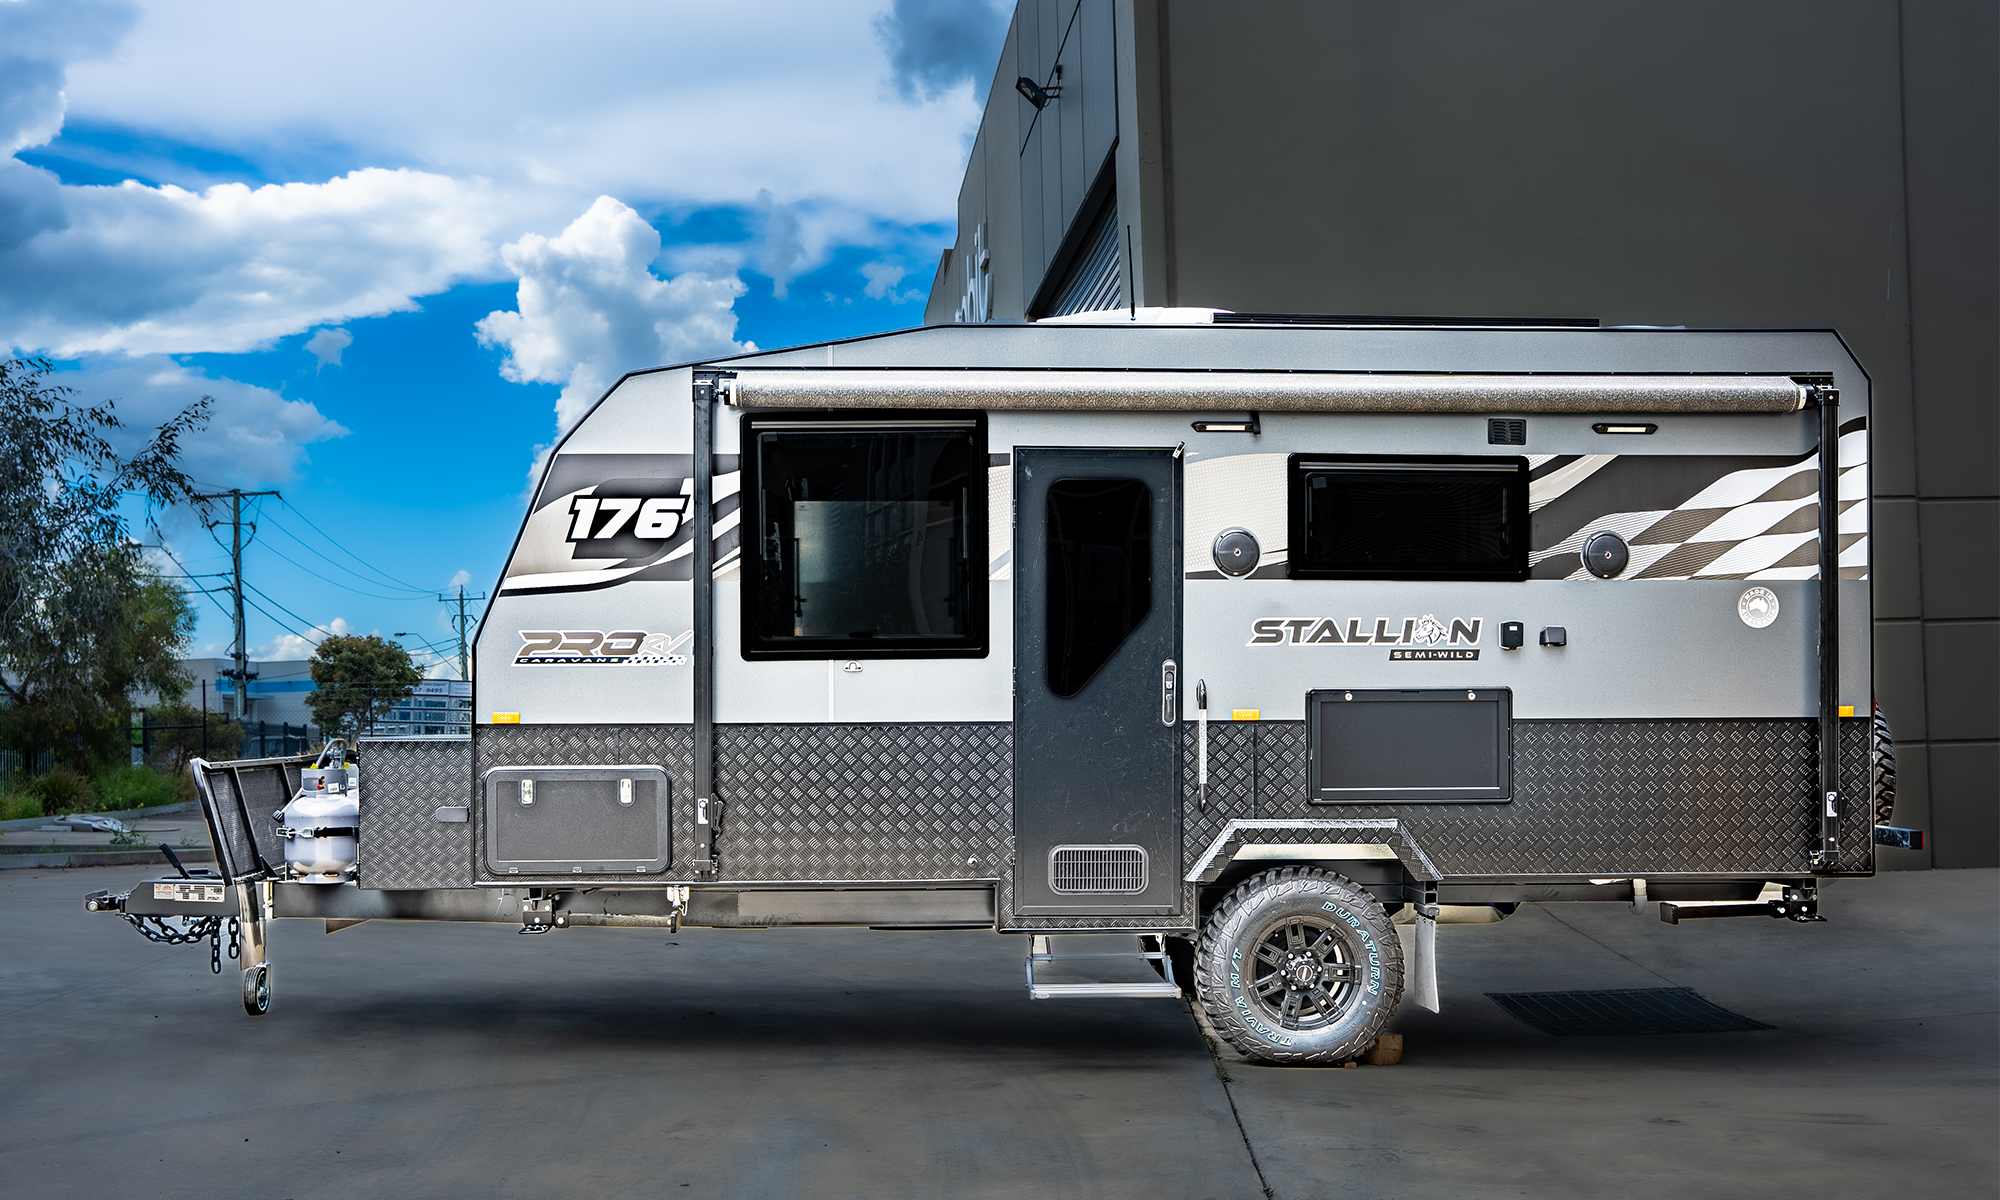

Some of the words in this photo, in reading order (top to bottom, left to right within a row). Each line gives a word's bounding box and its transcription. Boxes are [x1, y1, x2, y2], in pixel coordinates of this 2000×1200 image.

[570, 498, 686, 539] 176
[1744, 589, 1765, 600] MADE
[1765, 592, 1774, 601] IN
[518, 632, 647, 656] PRO
[639, 631, 692, 657] RV
[1251, 617, 1481, 644] STALLIN
[1393, 651, 1474, 659] SEMI-WILD
[1321, 901, 1381, 996] DURATURN
[1230, 947, 1242, 989] M/T
[1235, 996, 1293, 1047] TRAVIA
